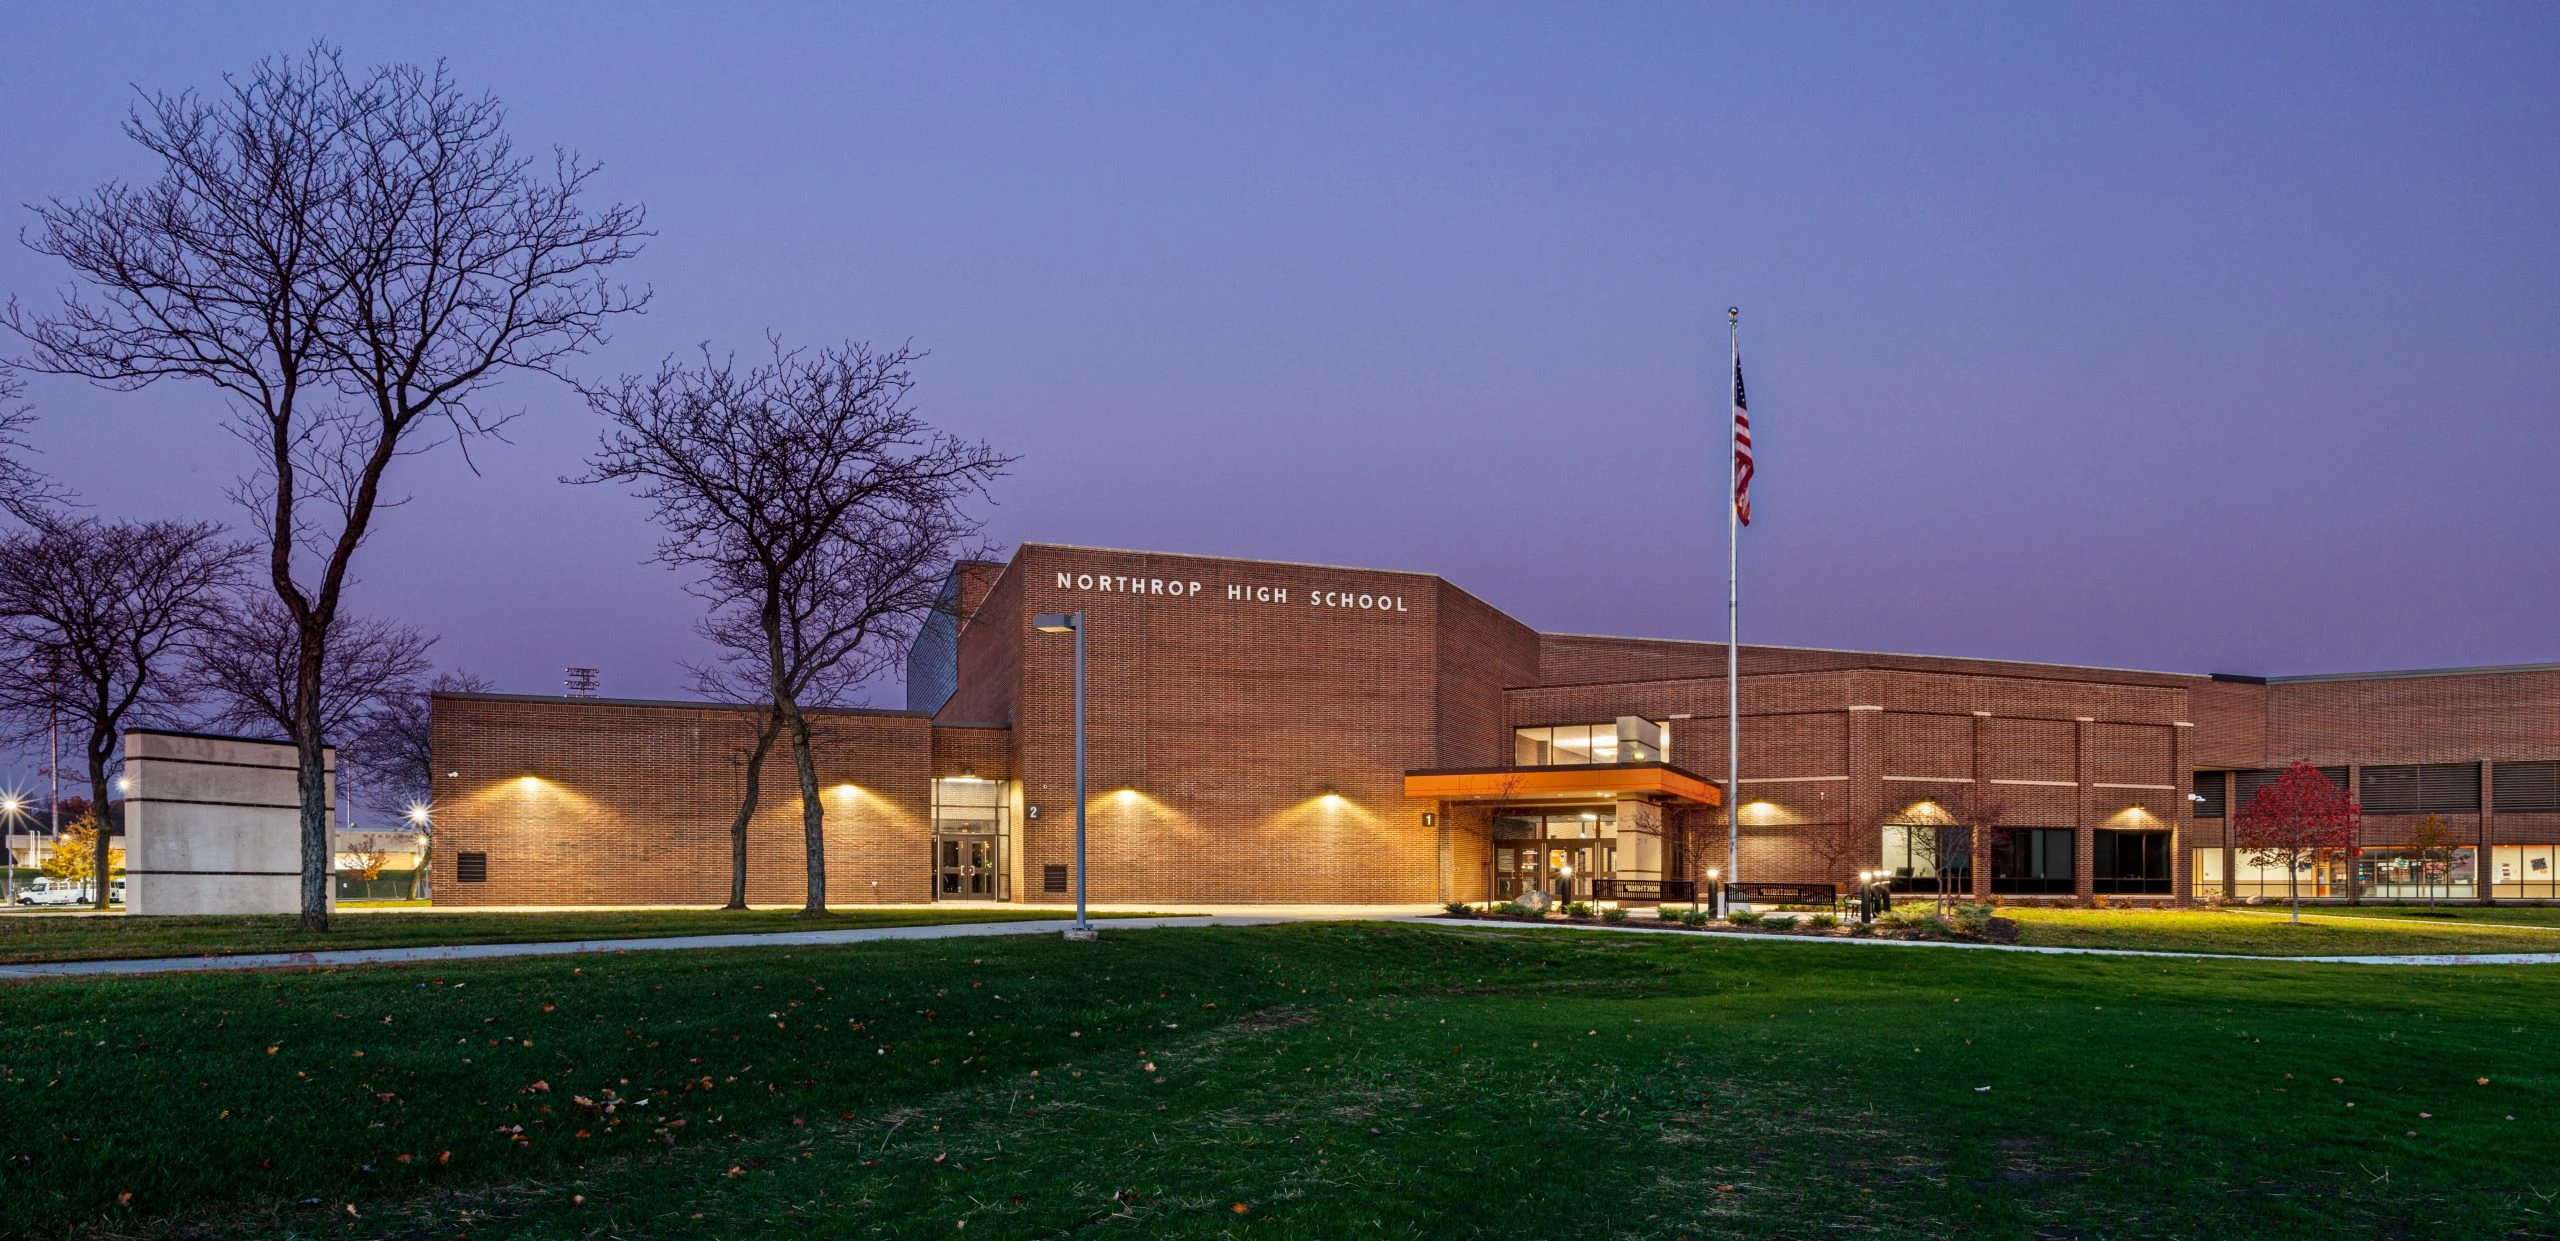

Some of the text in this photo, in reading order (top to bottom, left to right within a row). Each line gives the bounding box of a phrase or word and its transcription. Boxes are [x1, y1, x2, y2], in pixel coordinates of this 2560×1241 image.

[1057, 572, 1408, 612] NORTHROP HIGH SCHOOL
[1030, 806, 1037, 818] 2
[1425, 814, 1431, 826] 1
